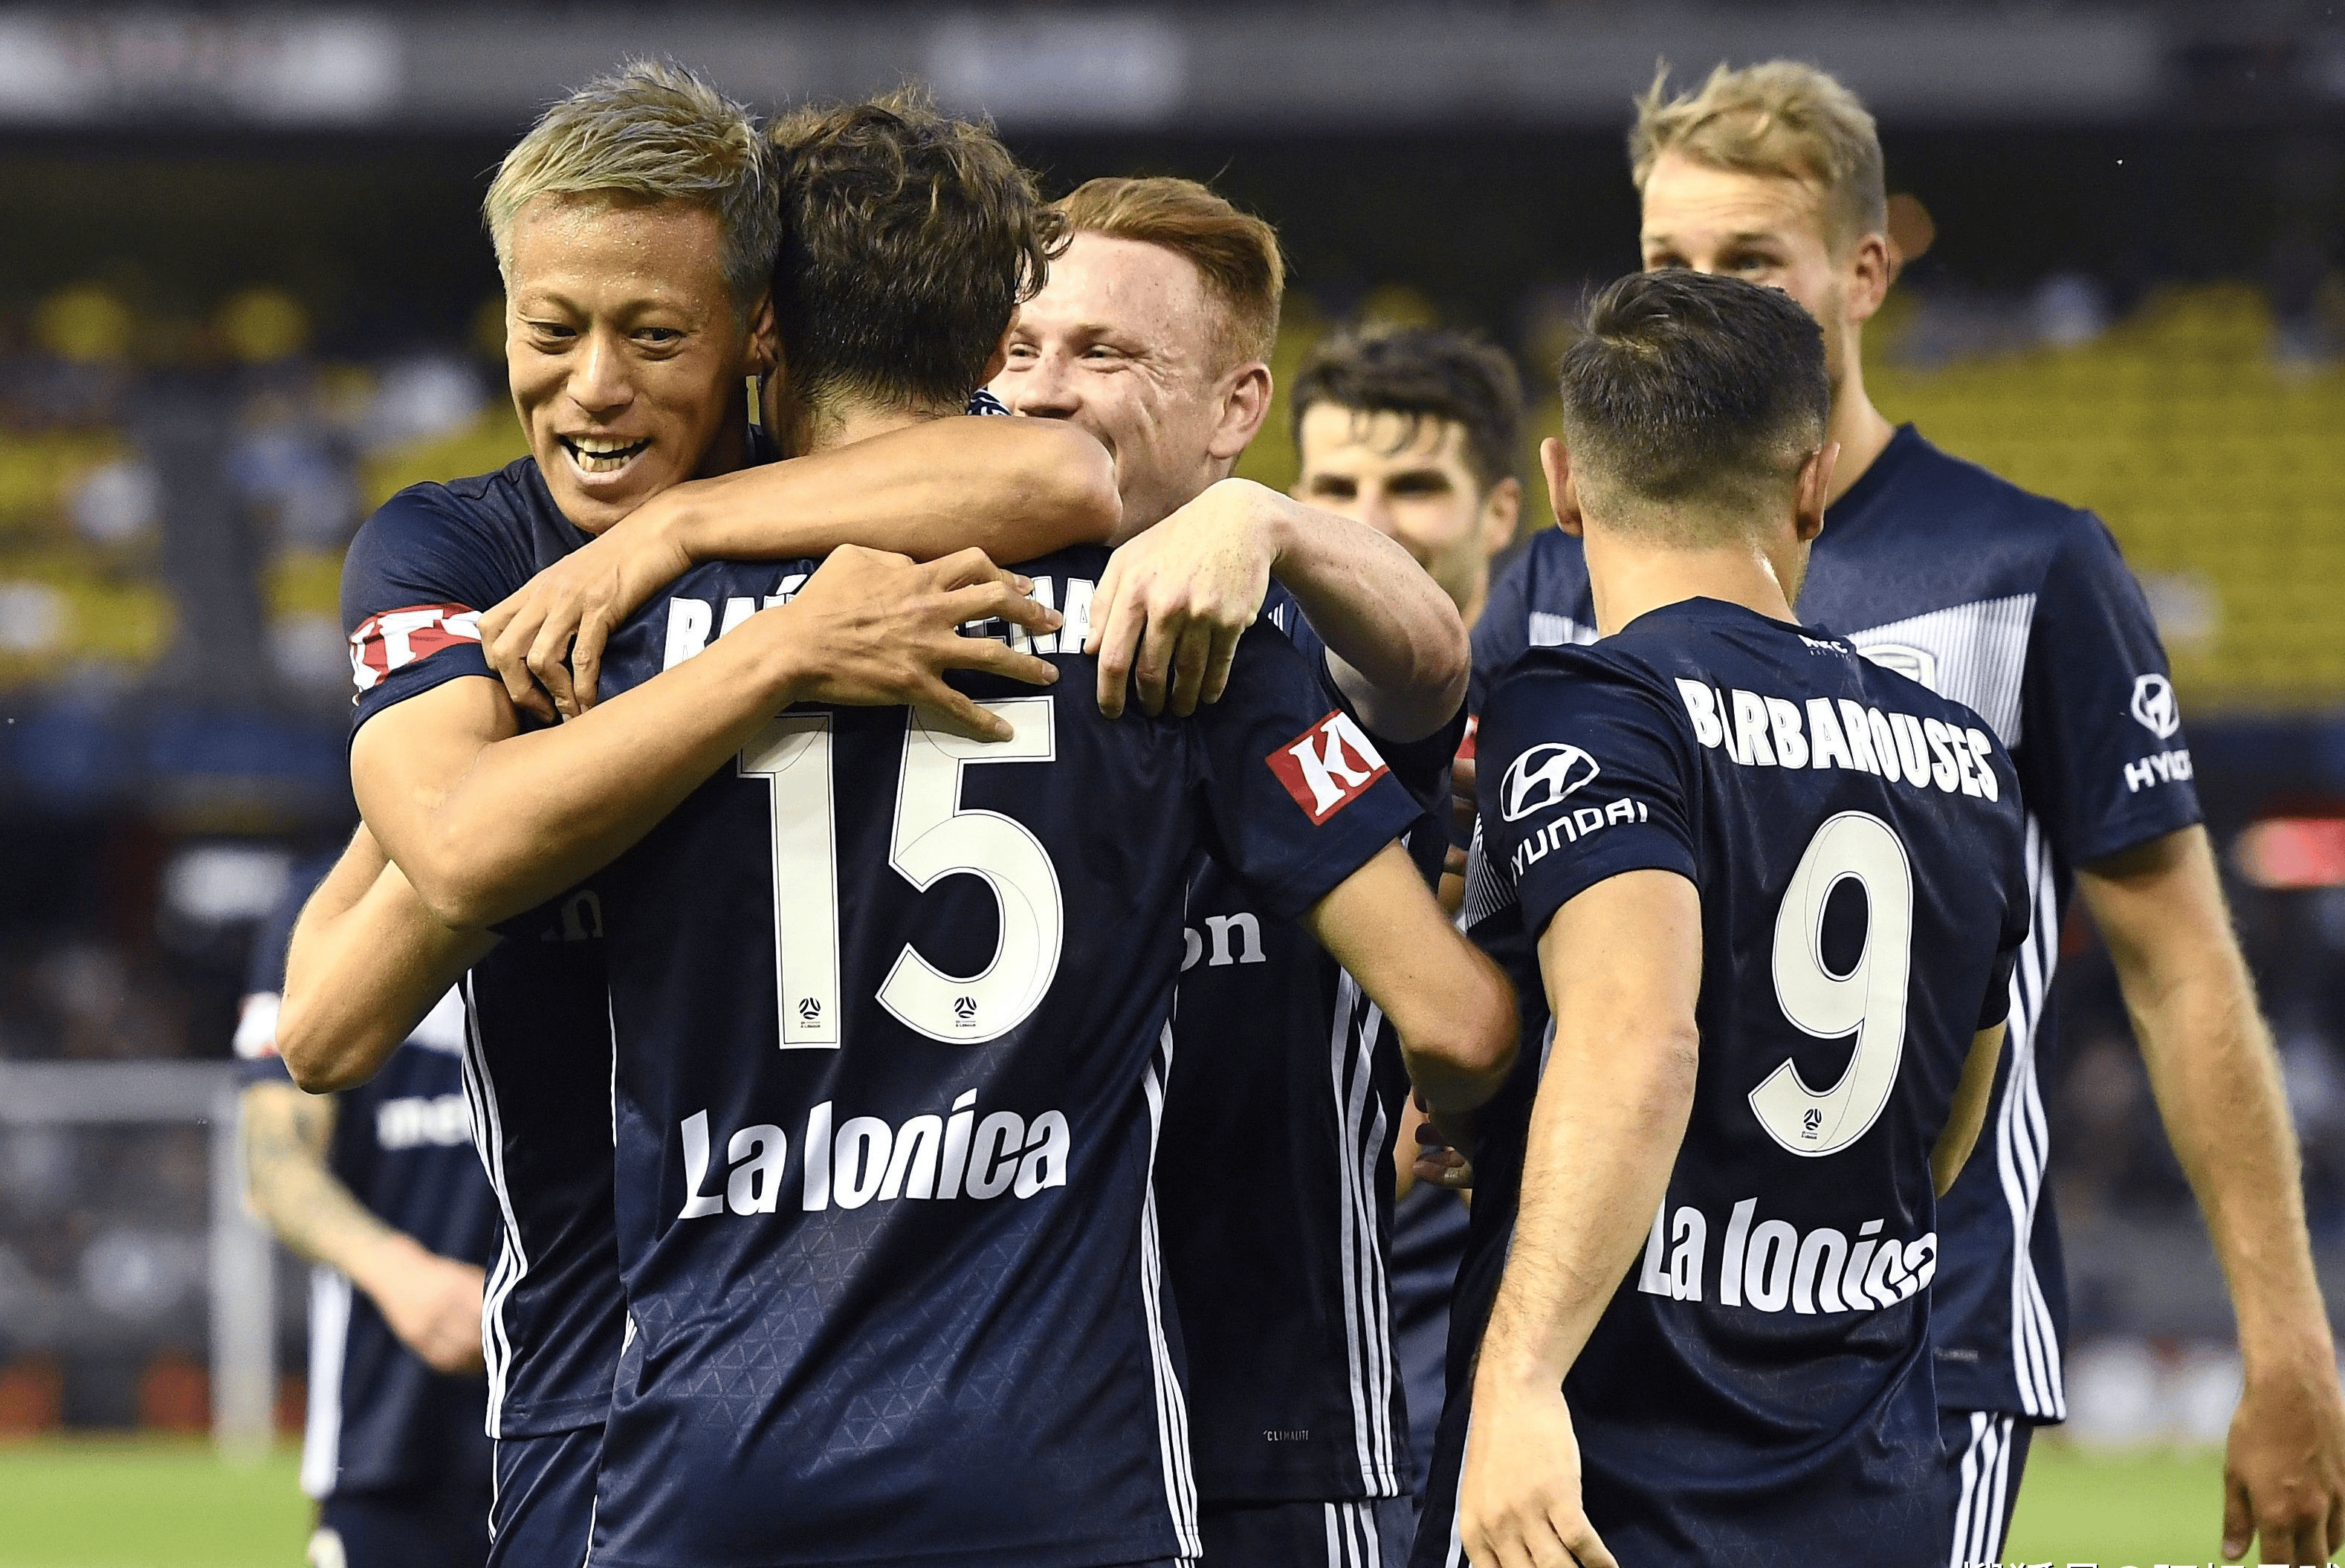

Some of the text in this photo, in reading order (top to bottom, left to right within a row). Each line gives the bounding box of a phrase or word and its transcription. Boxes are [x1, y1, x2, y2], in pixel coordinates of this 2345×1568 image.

[737, 695, 1064, 1050] 15
[1510, 797, 1648, 887] YUNDAI
[1747, 810, 1913, 1158] 9
[677, 1108, 788, 1219] La
[1637, 1194, 1707, 1301] La
